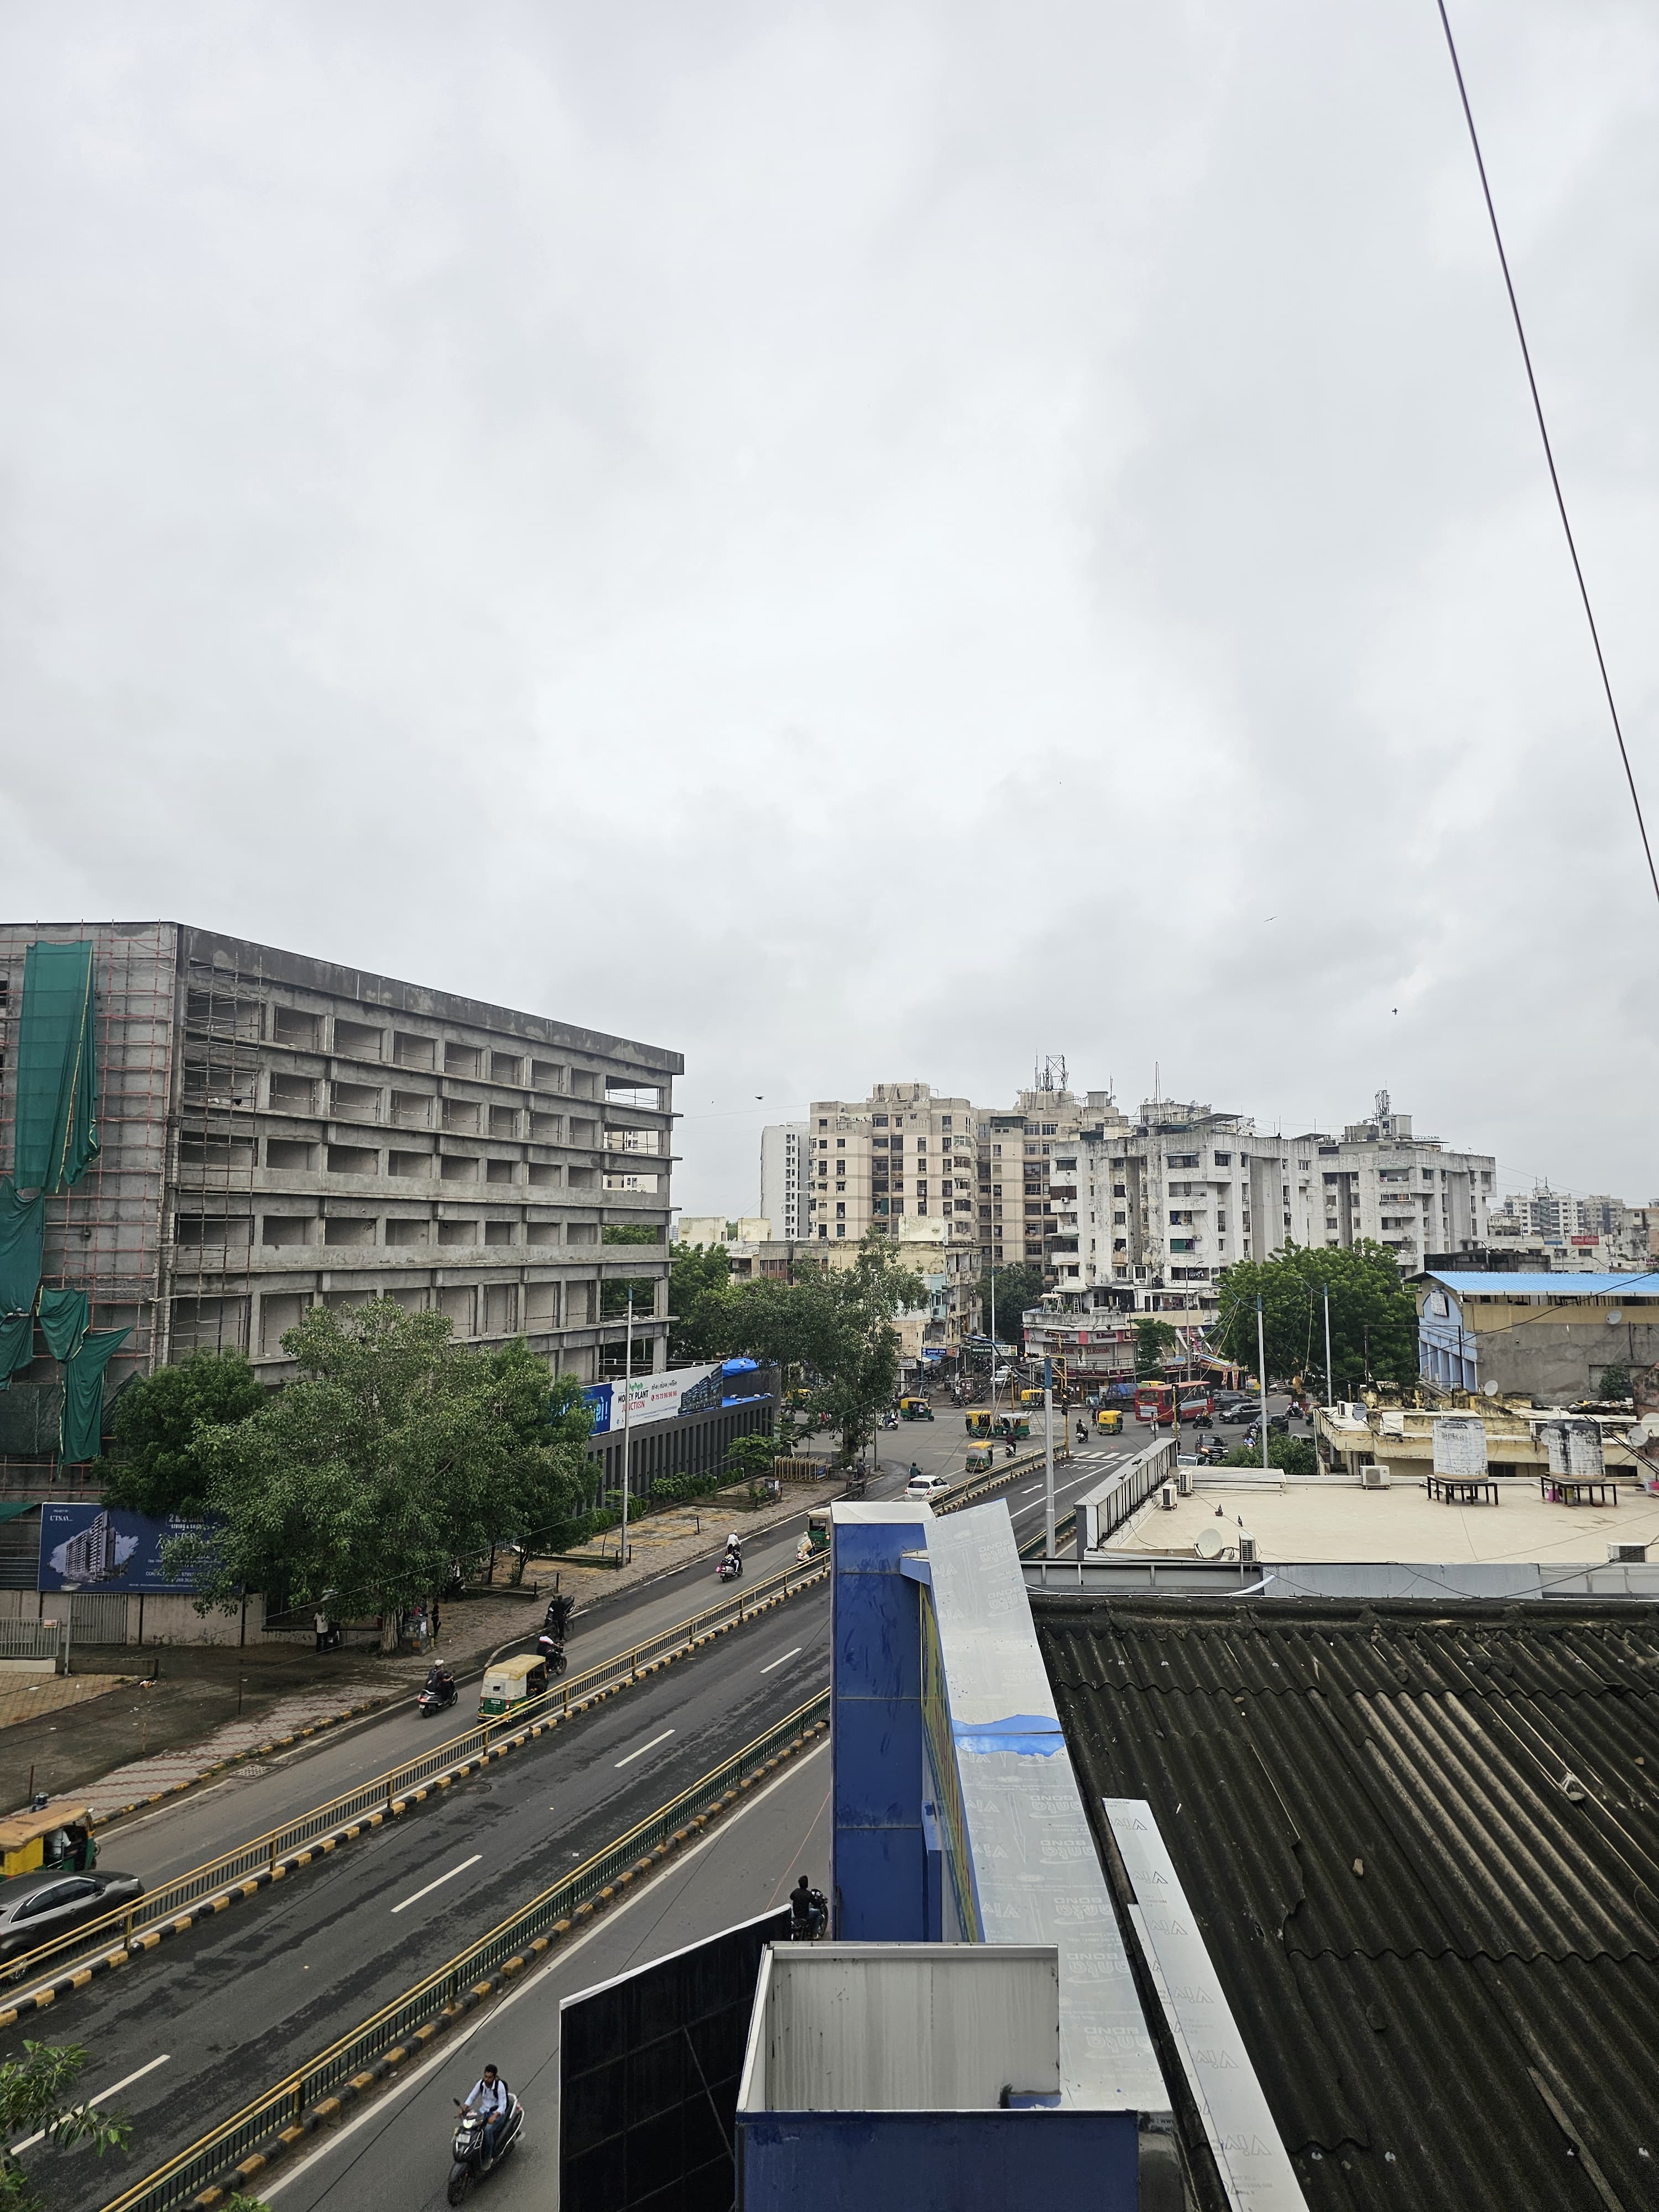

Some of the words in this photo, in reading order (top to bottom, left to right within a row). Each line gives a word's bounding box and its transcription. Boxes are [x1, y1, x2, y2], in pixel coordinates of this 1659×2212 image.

[1087, 1345, 1110, 1355] D.Ronak
[618, 1392, 635, 1404] MOEY
[635, 1390, 649, 1401] PLANT
[169, 1513, 174, 1522] 2
[1083, 2026, 1139, 2034] BOND
